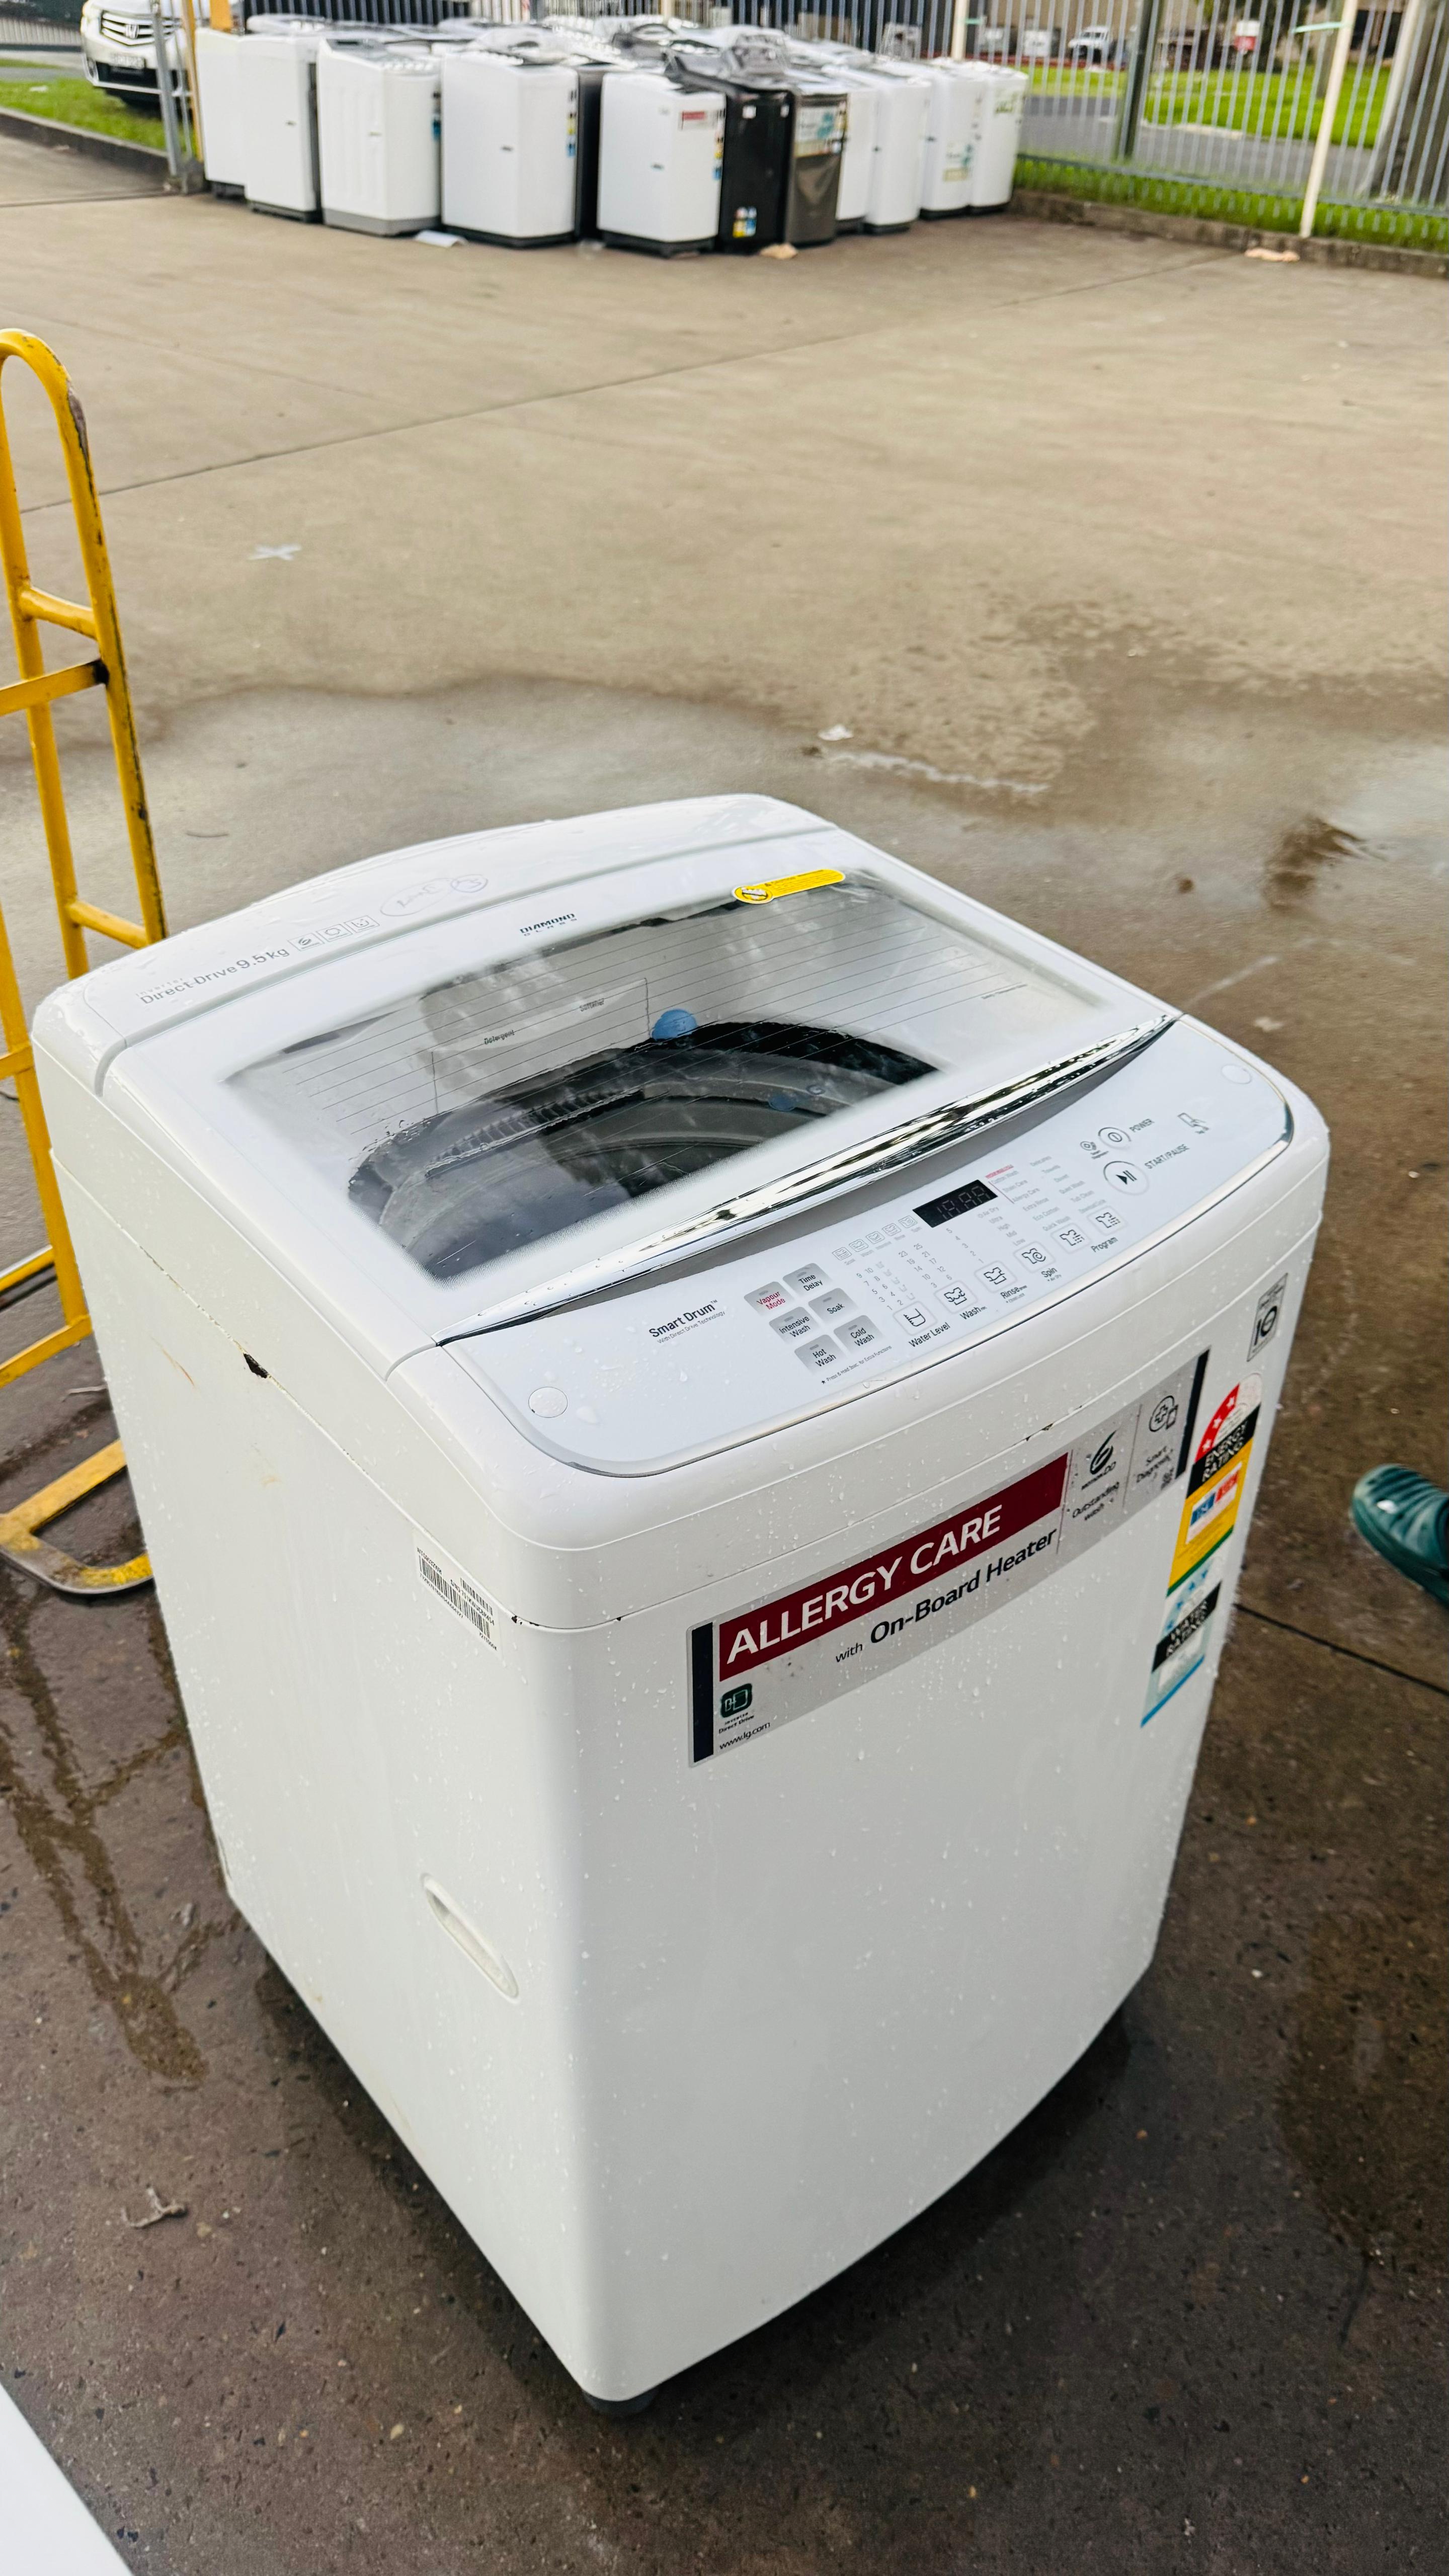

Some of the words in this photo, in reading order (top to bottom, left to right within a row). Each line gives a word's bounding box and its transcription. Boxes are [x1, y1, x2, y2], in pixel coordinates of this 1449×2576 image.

[520, 913, 575, 934] DIAMOND
[140, 982, 193, 1004] Direct
[193, 966, 237, 985] Drive
[1129, 1118, 1155, 1133] POWER
[1145, 1144, 1190, 1169] START/PAUSE
[1091, 1237, 1118, 1253] Program
[798, 1274, 816, 1284] Time
[1041, 1267, 1058, 1277] Spin
[803, 1279, 823, 1292] Delay
[1000, 1287, 1020, 1299] Rinse
[757, 1291, 781, 1305] Vapour
[766, 1298, 786, 1310] Mode
[827, 1303, 845, 1314] Soak
[960, 1306, 981, 1320] Wash
[649, 1317, 686, 1337] Smart
[670, 1329, 685, 1339] Direct
[684, 1323, 699, 1332] Drive
[697, 1311, 726, 1325] Technology
[779, 1315, 810, 1334] Intensive
[789, 1324, 811, 1337] Wash
[850, 1327, 867, 1339] Cold
[854, 1333, 875, 1347] Wash
[909, 1331, 931, 1347] Water
[930, 1322, 950, 1336] Level
[813, 1348, 827, 1358] Hot
[815, 1353, 837, 1367] Wash
[1072, 1482, 1119, 1518] Outstanding
[727, 1556, 902, 1664] ALLERGY
[910, 1504, 1002, 1575] CARE
[835, 1642, 863, 1663] with
[870, 1570, 981, 1643] On-Board
[986, 1528, 1057, 1583] Heater
[718, 1723, 737, 1734] Direct
[739, 1715, 754, 1724] Drive
[719, 1723, 770, 1749] www.lg.com
